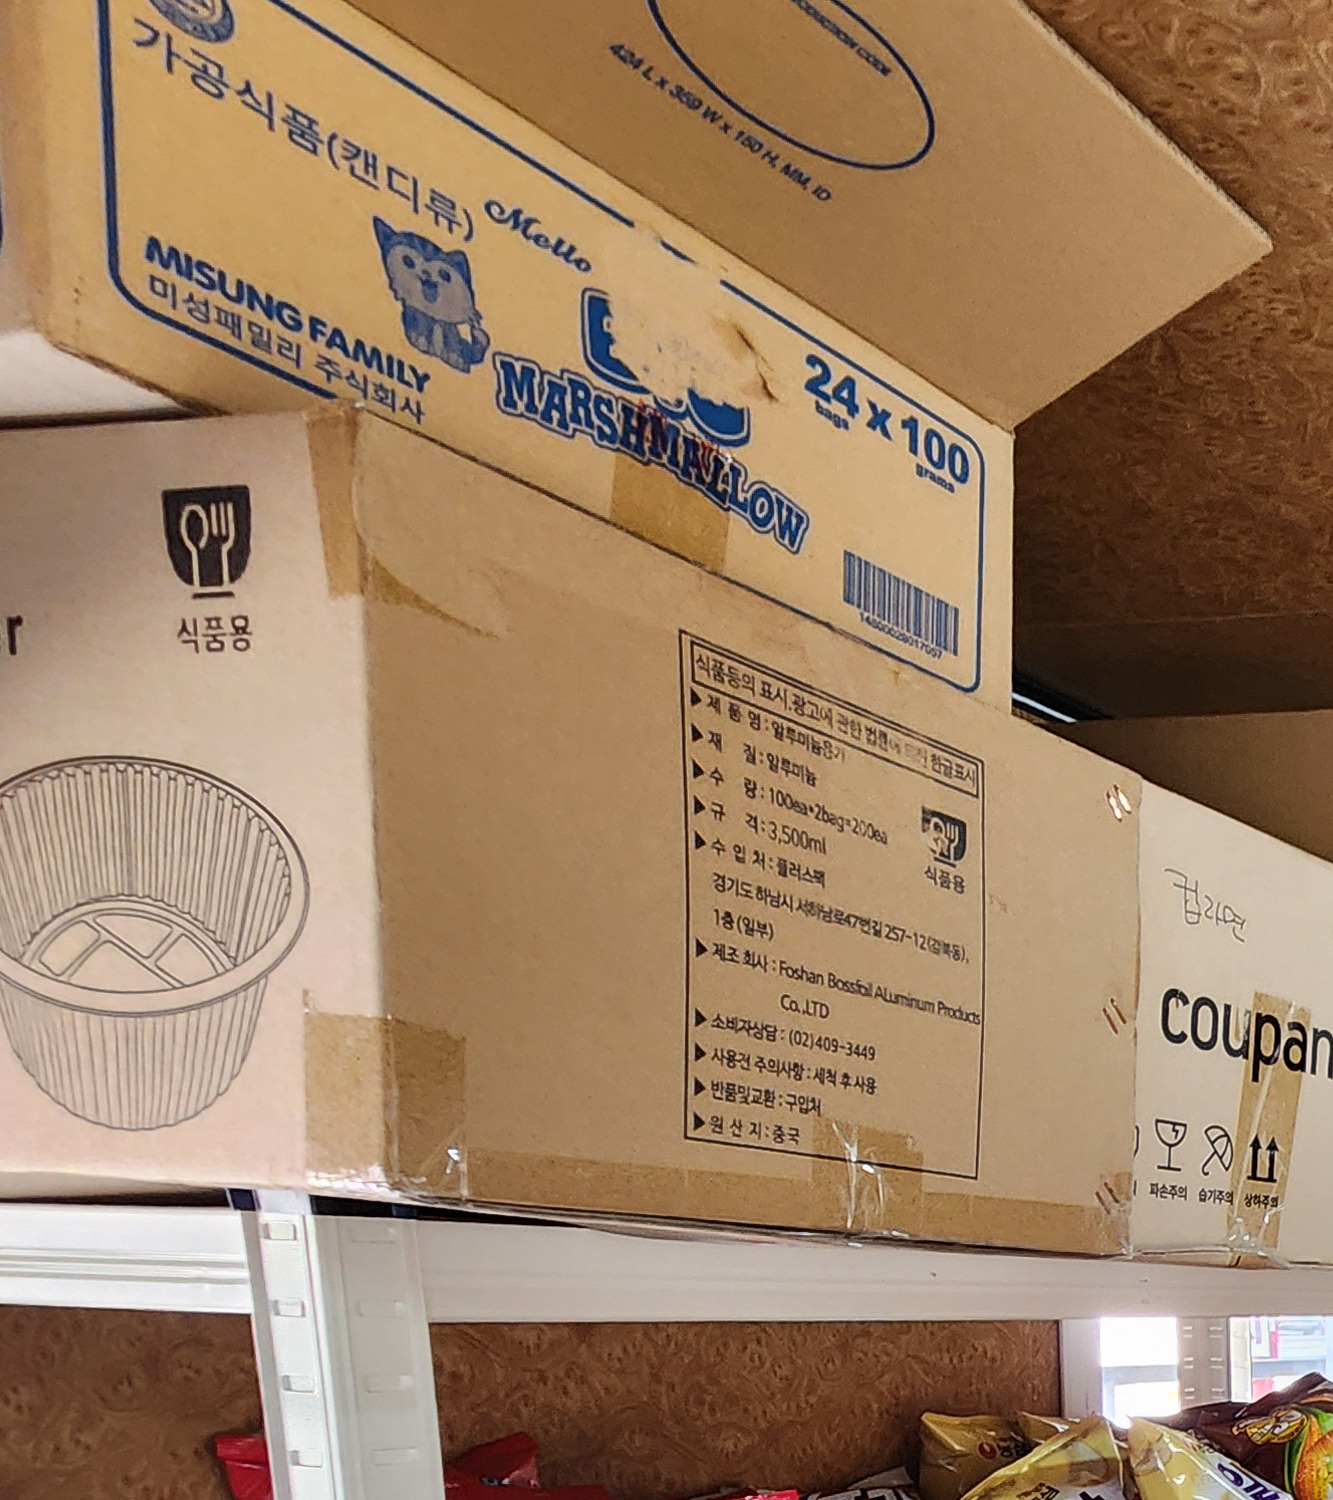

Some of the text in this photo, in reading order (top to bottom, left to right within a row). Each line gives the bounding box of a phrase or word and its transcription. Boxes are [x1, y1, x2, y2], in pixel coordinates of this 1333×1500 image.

[133, 17, 474, 242] 가공식품(캔디류)
[701, 105, 723, 124] W
[484, 199, 592, 274] Mello
[145, 236, 431, 393] MISUNG FAMILY
[149, 273, 426, 426] 미성패밀리 주식회사
[804, 354, 859, 418] 24
[901, 416, 970, 485] 100
[815, 400, 850, 431] bags
[494, 352, 809, 554] MARSHMALLOW
[916, 463, 955, 494] grams
[177, 614, 253, 654] 식품용
[768, 820, 827, 855] 3,500ml
[712, 872, 754, 900] 경기도
[755, 885, 794, 913] 하남시
[924, 864, 965, 895] 식품용
[779, 960, 824, 989] Foshan
[937, 1000, 981, 1026] Products
[788, 1028, 876, 1062] (02)409-3449
[711, 1047, 751, 1072] 사용전
[813, 1066, 837, 1087] 세척
[785, 1092, 822, 1116] 구입처
[772, 1124, 800, 1145] 중국
[1150, 1182, 1188, 1201] 파손주의
[1198, 1187, 1234, 1206] 습기주의
